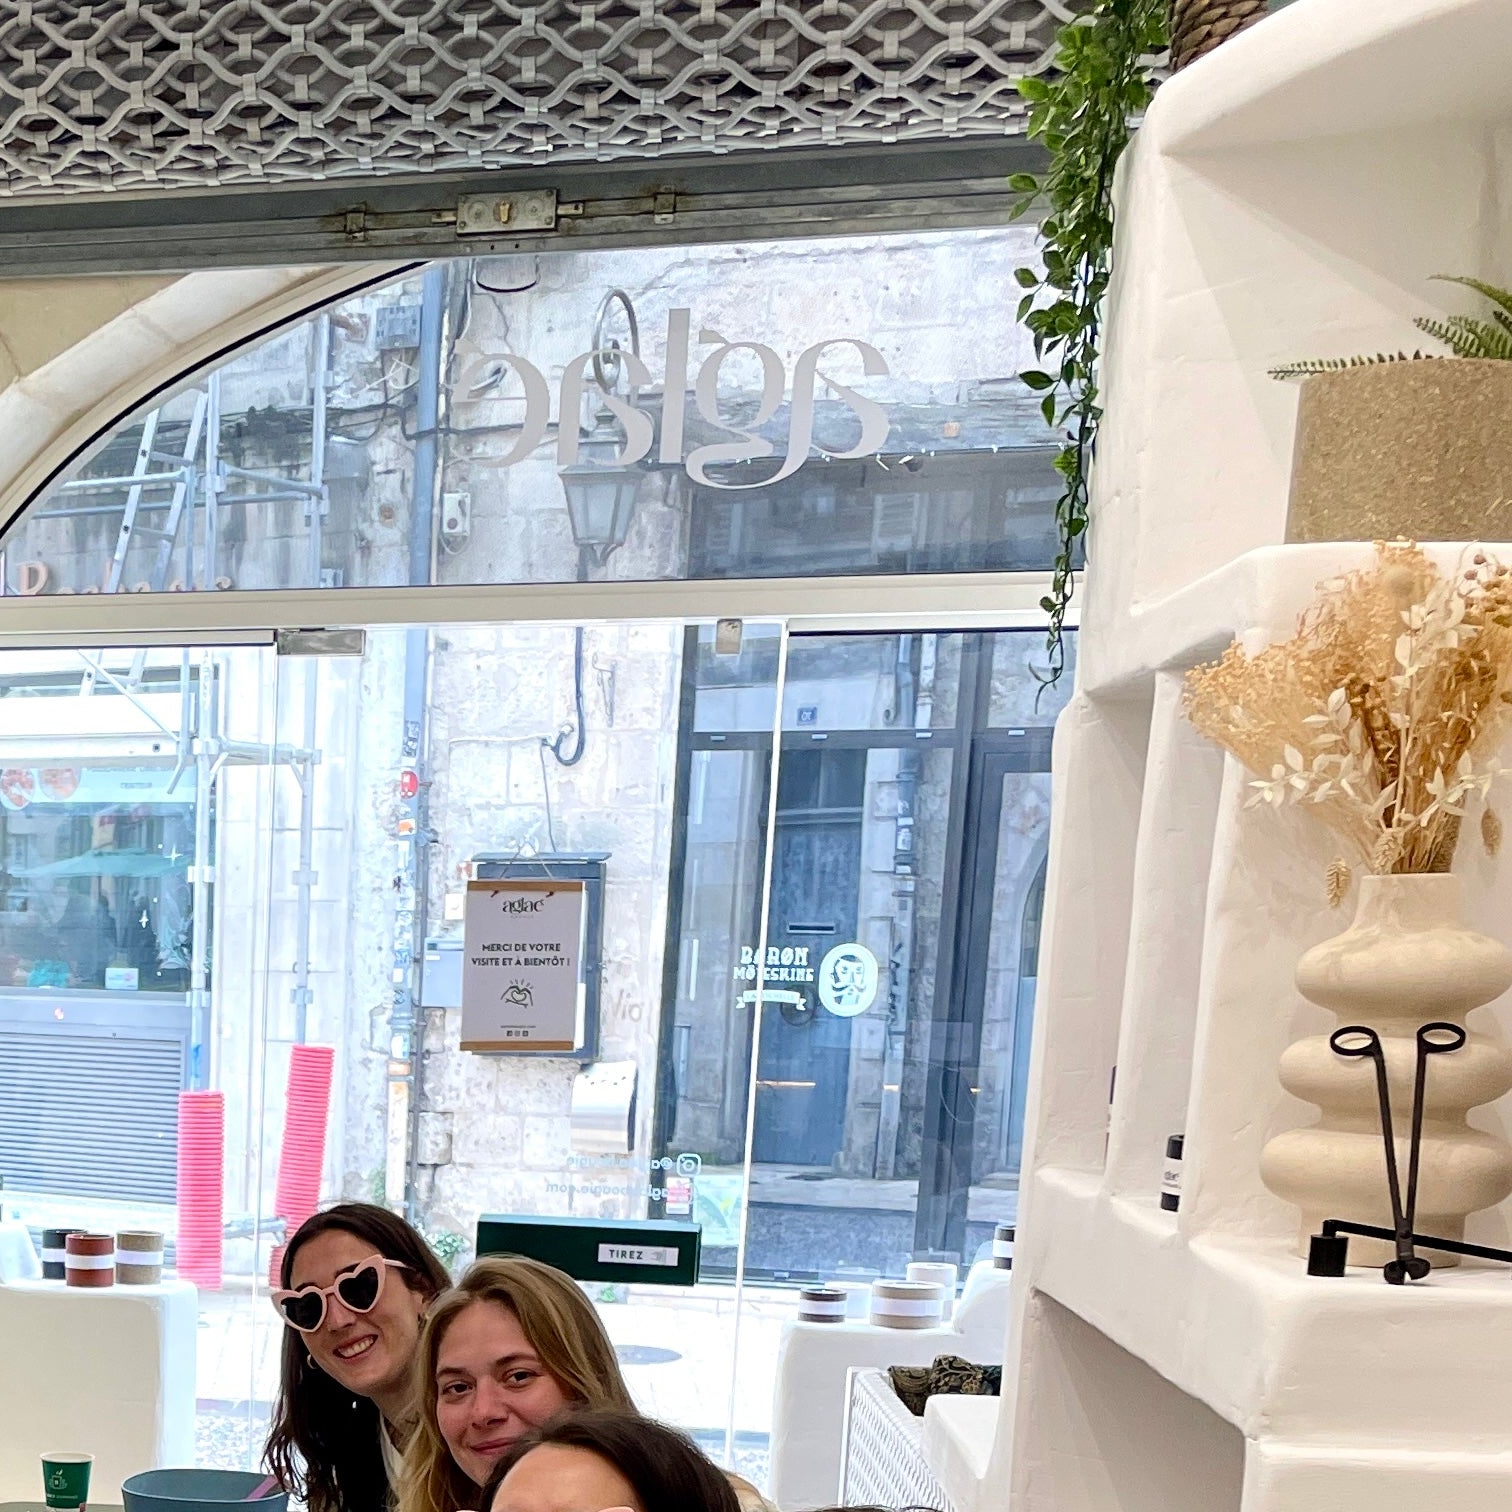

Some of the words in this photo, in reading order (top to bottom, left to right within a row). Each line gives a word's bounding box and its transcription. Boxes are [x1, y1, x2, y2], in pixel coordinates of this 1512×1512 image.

[482, 943, 512, 952] MERCI
[514, 943, 527, 952] DE
[529, 943, 561, 952] VOTRE
[471, 957, 500, 966] VISITE
[502, 957, 513, 966] ET
[524, 955, 565, 966] BIENTÔT
[609, 1249, 643, 1260] TIREZ
